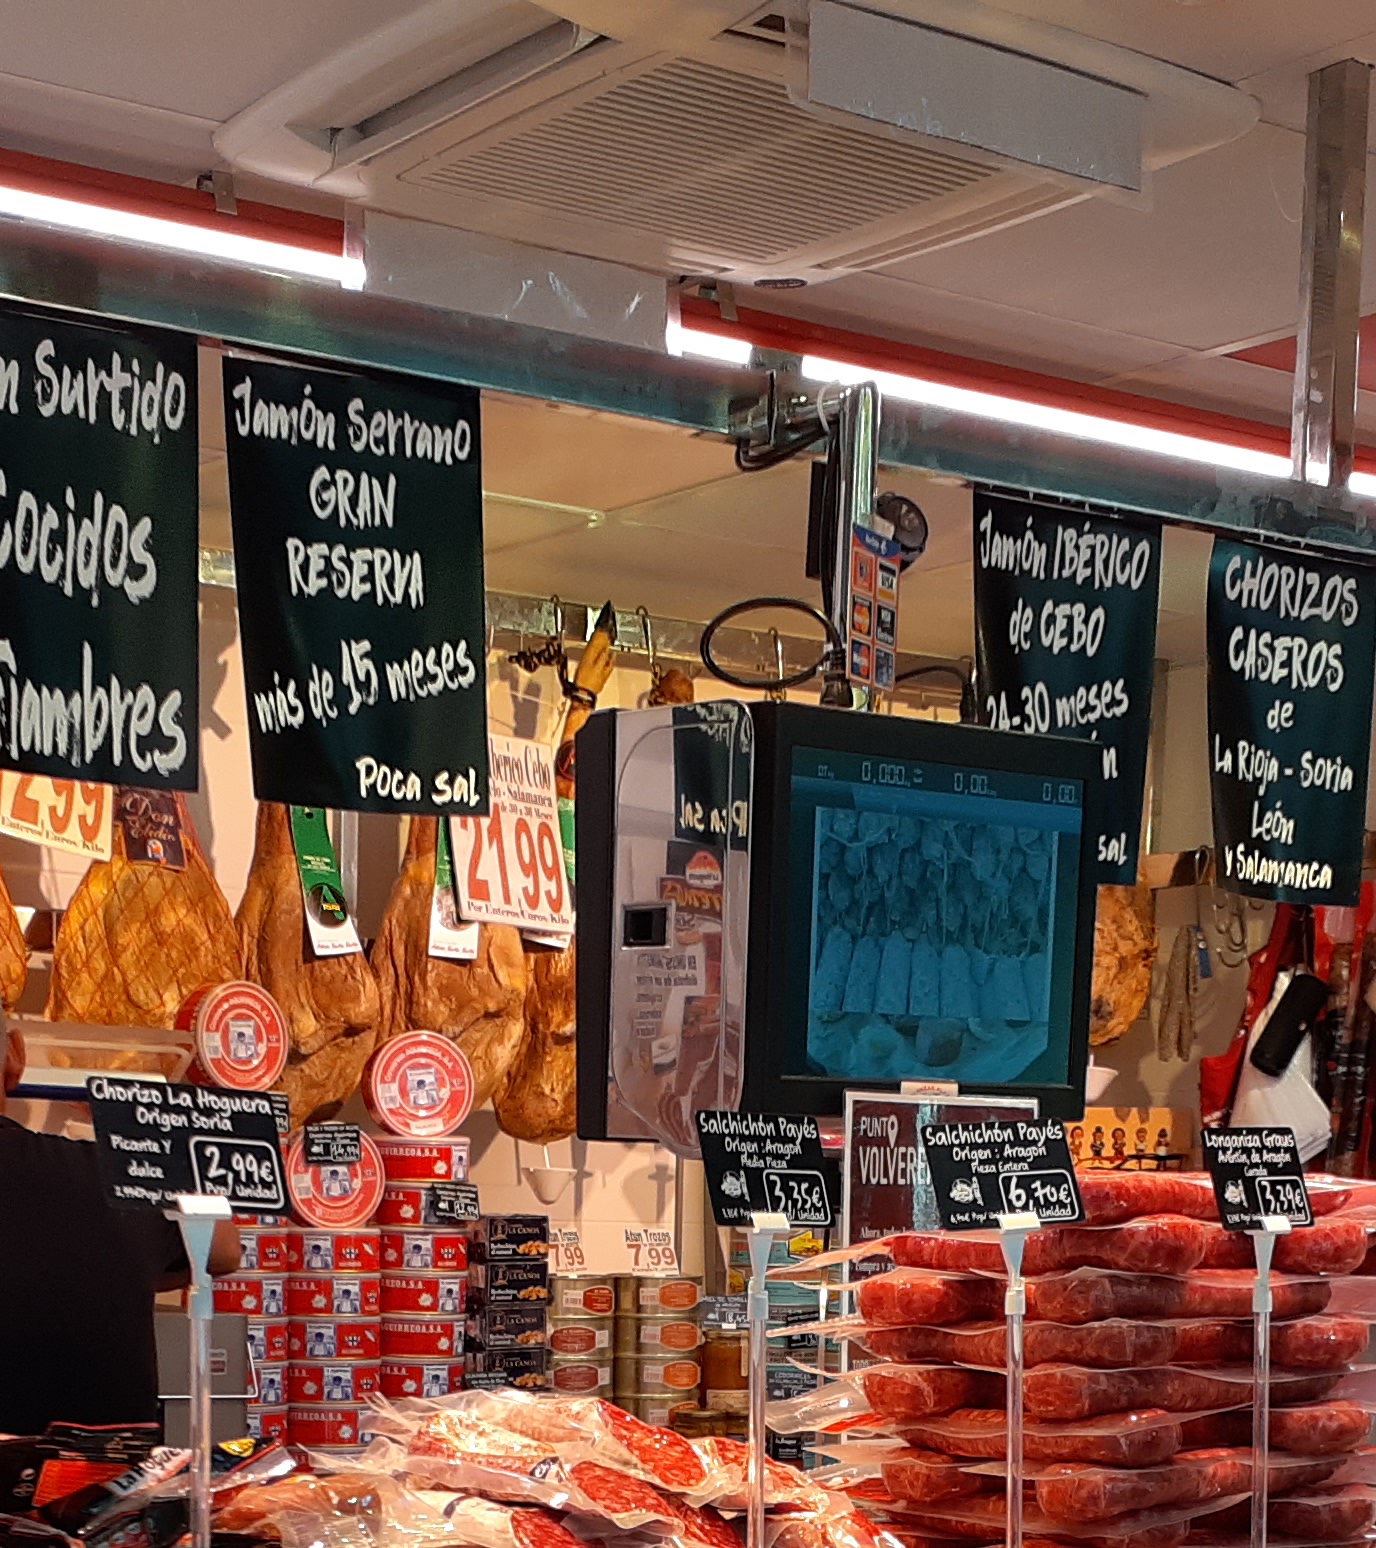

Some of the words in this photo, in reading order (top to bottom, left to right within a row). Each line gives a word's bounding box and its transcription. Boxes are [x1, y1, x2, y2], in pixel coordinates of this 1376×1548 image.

[35, 338, 186, 443] Surtido
[233, 376, 337, 451] Jamón
[348, 397, 471, 466] Serrano
[310, 465, 397, 529] GRAN
[286, 537, 425, 609] RESERVA
[979, 509, 1047, 581] Jamón
[1053, 521, 1151, 591] IBÉRICO
[1225, 554, 1359, 627] CHORIZOS
[1009, 597, 1034, 655] de
[1040, 599, 1105, 659] CEBO
[308, 676, 338, 728] de
[340, 639, 379, 716] 15
[386, 640, 477, 703] meses
[1229, 625, 1345, 693] CASEROS
[1056, 677, 1130, 729] meses
[1266, 699, 1295, 733] de
[1214, 733, 1233, 775] La
[1238, 739, 1279, 796] Rioja
[1301, 750, 1355, 794] Soria
[1251, 800, 1295, 846] León
[1237, 842, 1333, 891] Salamanca
[92, 1078, 163, 1105] Chorizo
[167, 1085, 194, 1108] La
[197, 1088, 273, 1117] Hoguera
[700, 1112, 776, 1136] Salchichón
[778, 1116, 817, 1145] Payés
[926, 1122, 1013, 1147] Salchichón
[1017, 1119, 1063, 1145] Payés
[1204, 1131, 1262, 1153] Longaniza
[1262, 1131, 1295, 1149] Graus
[205, 1145, 274, 1184] 2,99€
[859, 1146, 931, 1186] VOLVERE
[769, 1174, 823, 1213] 3,35€
[1008, 1175, 1072, 1212] 6,70€
[1261, 1181, 1305, 1214] 3,39€
